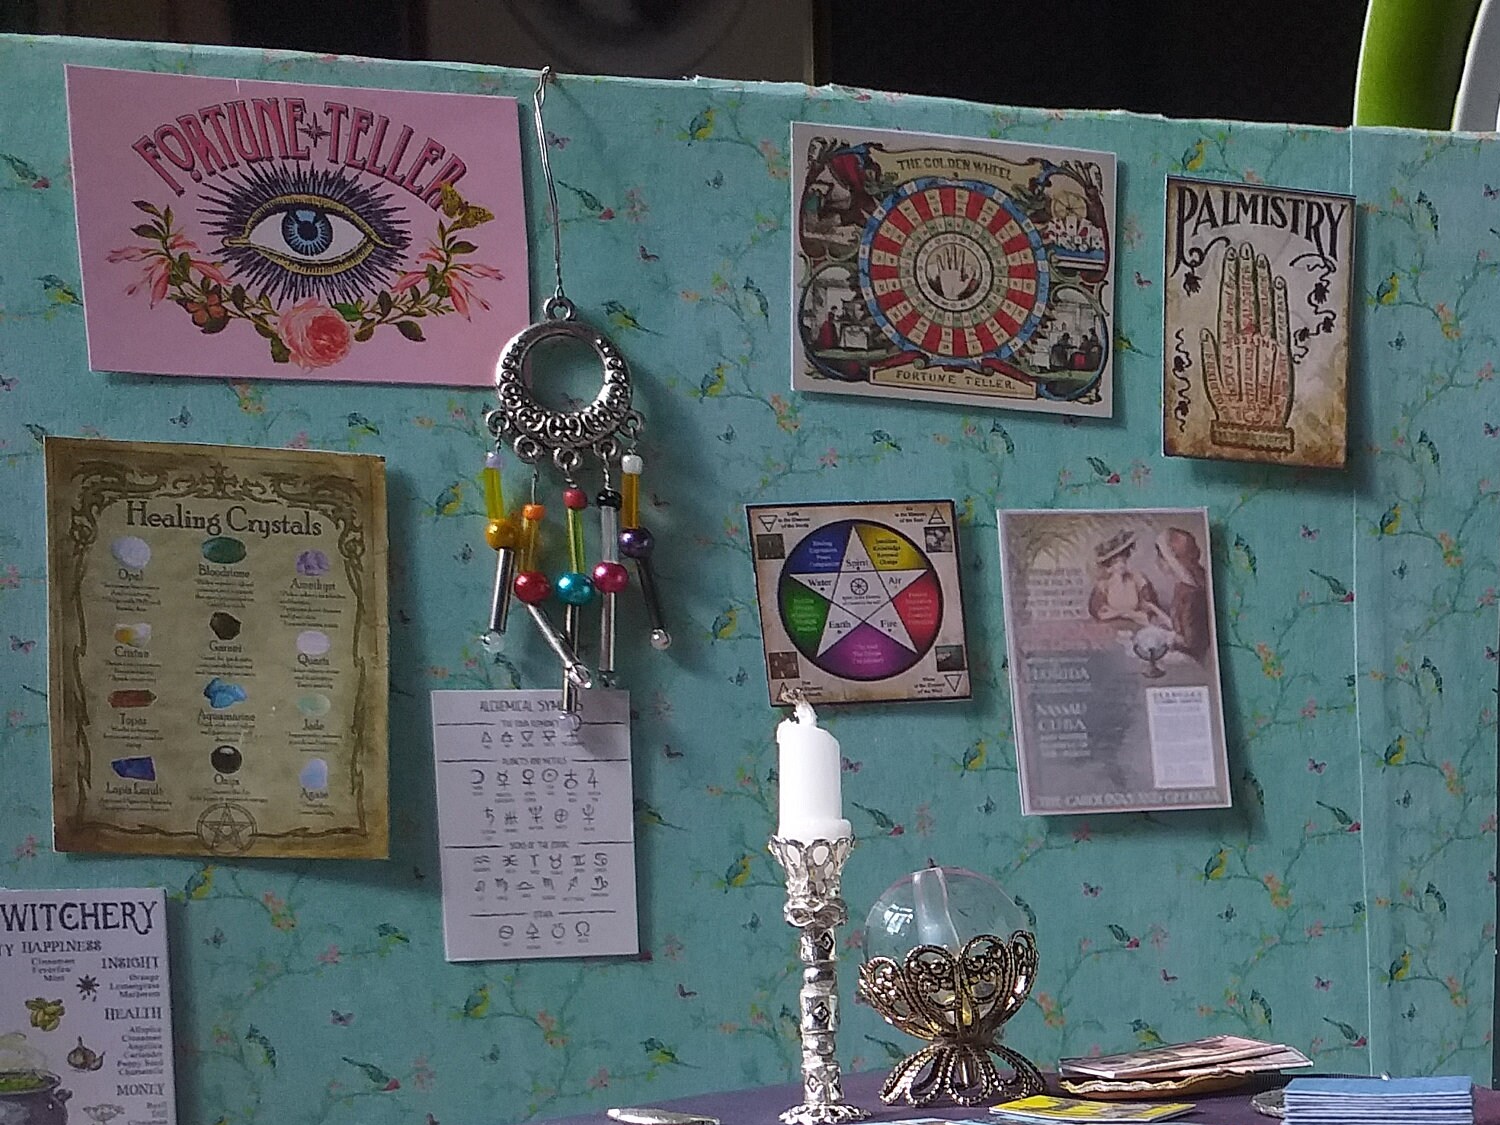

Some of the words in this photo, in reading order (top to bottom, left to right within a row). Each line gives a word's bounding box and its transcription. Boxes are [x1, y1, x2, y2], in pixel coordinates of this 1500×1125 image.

[132, 97, 311, 197] FORTUNE
[324, 101, 468, 211] TELLER
[897, 157, 922, 170] THE
[925, 157, 971, 172] GOLDEN
[973, 161, 1012, 181] WHEEL
[1170, 186, 1348, 278] PALMISTRY
[896, 370, 956, 384] FORTUNE
[127, 500, 223, 536] Healing
[226, 505, 322, 538] Crystals
[846, 559, 869, 569] Spirit
[808, 578, 832, 587] Water
[888, 576, 902, 585] Air
[829, 620, 851, 629] Earth
[880, 619, 898, 629] Fire
[1038, 717, 1087, 731] CUBA
[0, 901, 158, 936] WITCHERY
[22, 939, 102, 954] HAPPINESS
[101, 956, 160, 970] INSIGHT
[104, 1006, 162, 1020] HEALTH
[117, 1083, 166, 1096] MONEY
